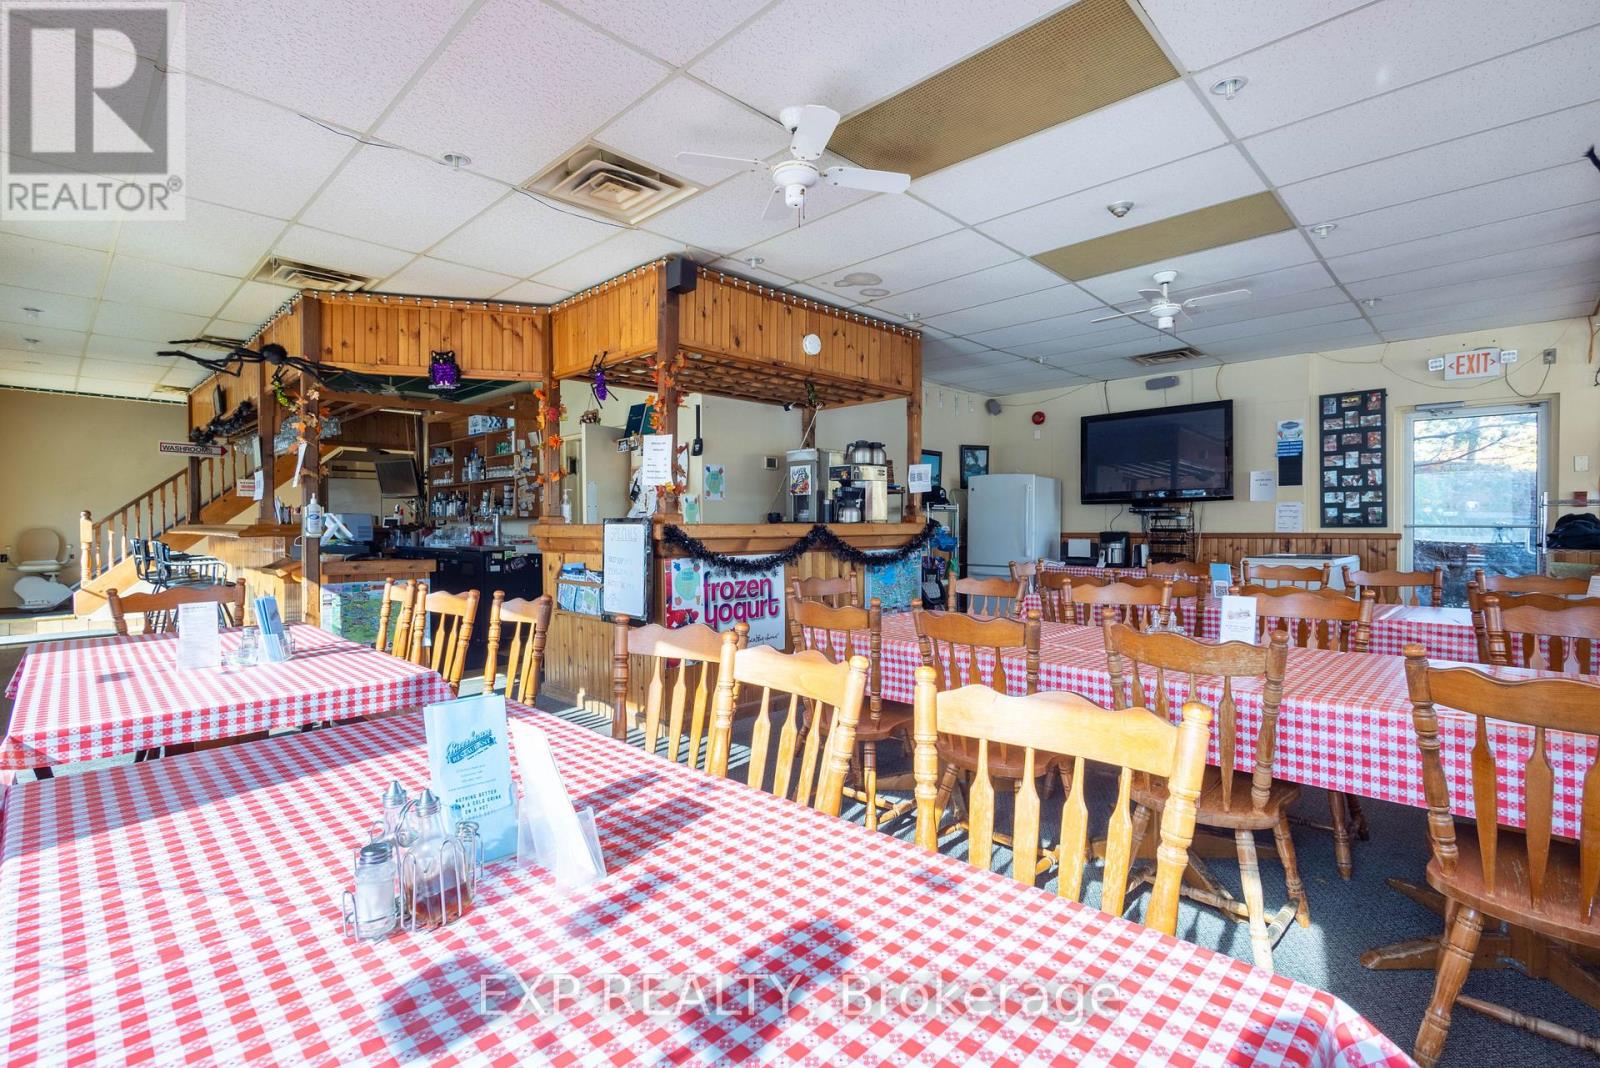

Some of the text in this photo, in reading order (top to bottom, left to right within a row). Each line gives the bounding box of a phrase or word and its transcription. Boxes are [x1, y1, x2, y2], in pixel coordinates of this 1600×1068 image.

[1455, 352, 1491, 375] EXIT
[162, 445, 213, 454] WASHROOMS
[704, 571, 772, 601] frozen
[704, 593, 780, 632] yogurt
[472, 798, 486, 806] COLD
[487, 794, 502, 802] DRINK
[478, 789, 497, 798] BETTER
